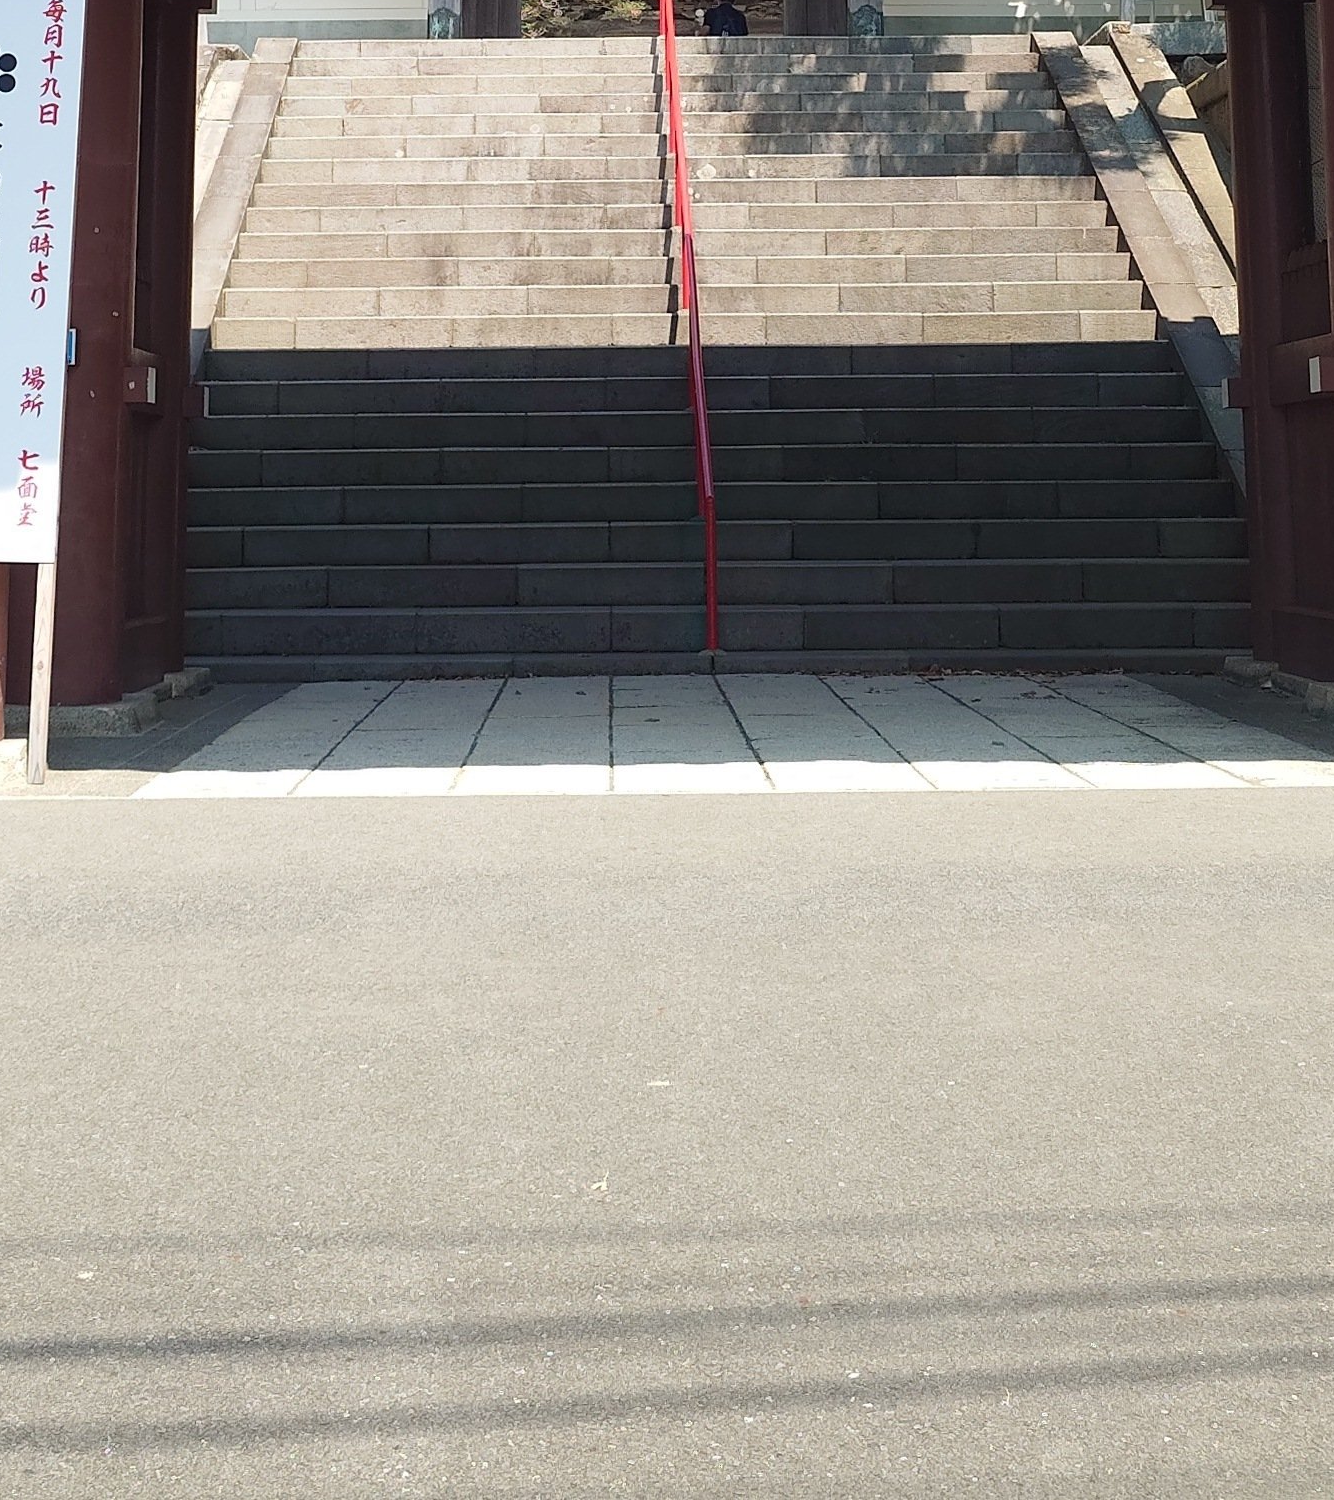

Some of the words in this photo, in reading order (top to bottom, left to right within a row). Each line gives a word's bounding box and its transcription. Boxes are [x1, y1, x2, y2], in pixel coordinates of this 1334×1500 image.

[29, 181, 56, 310] 十三時より
[20, 366, 46, 418] 場所
[17, 450, 40, 526] 七面堂
